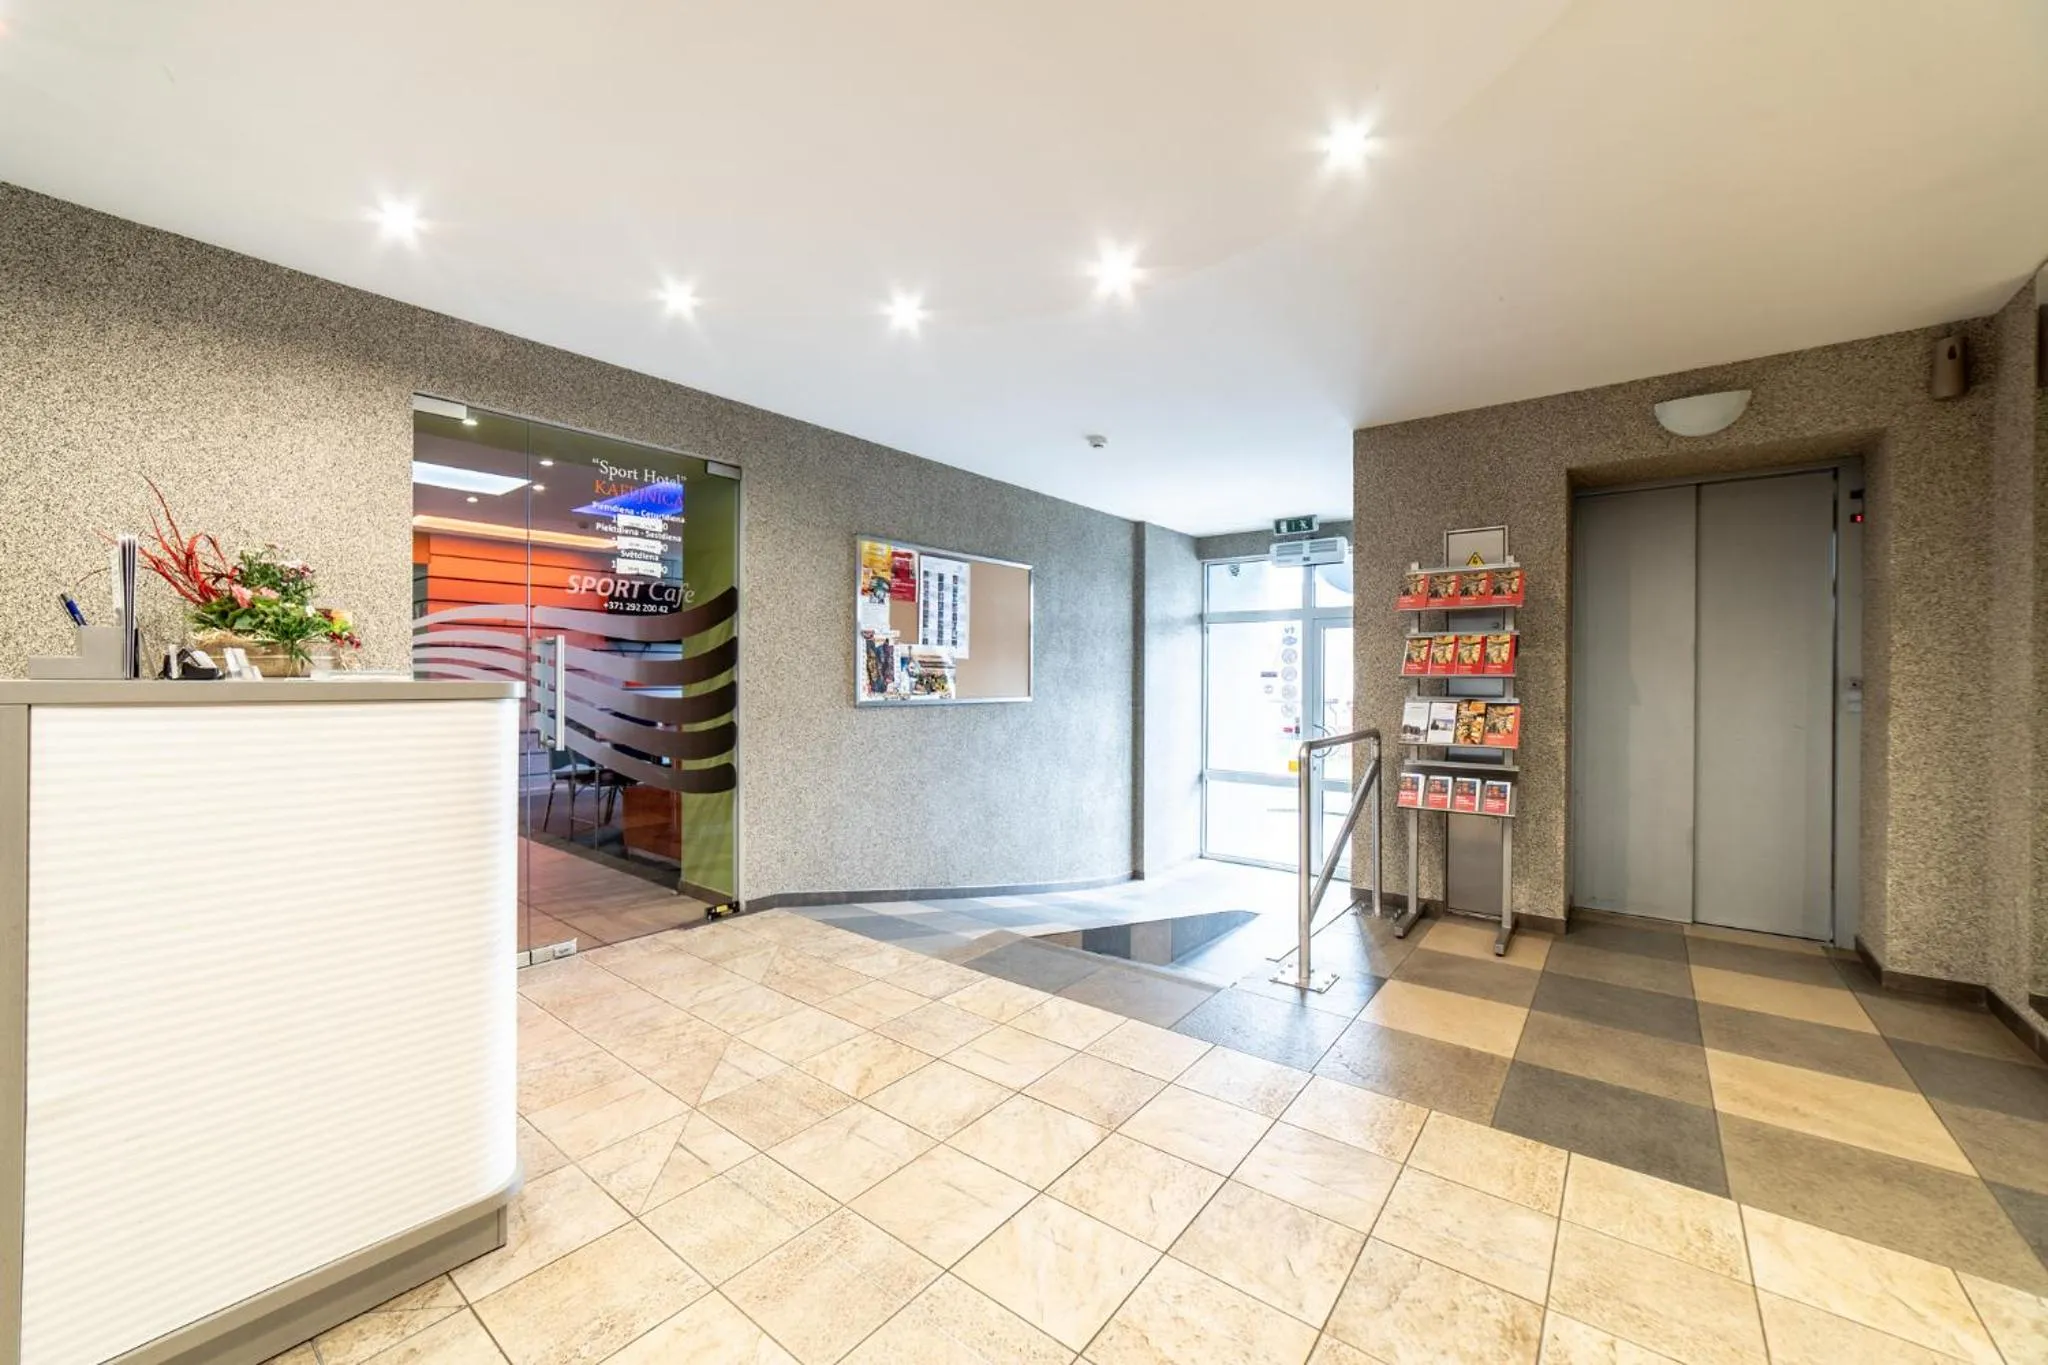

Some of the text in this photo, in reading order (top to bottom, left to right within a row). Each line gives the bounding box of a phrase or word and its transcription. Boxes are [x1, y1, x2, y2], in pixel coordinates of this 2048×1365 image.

[566, 574, 696, 609] SPORT Cafe
[603, 601, 624, 611] +371
[642, 603, 657, 613] 200
[658, 604, 669, 614] 42
